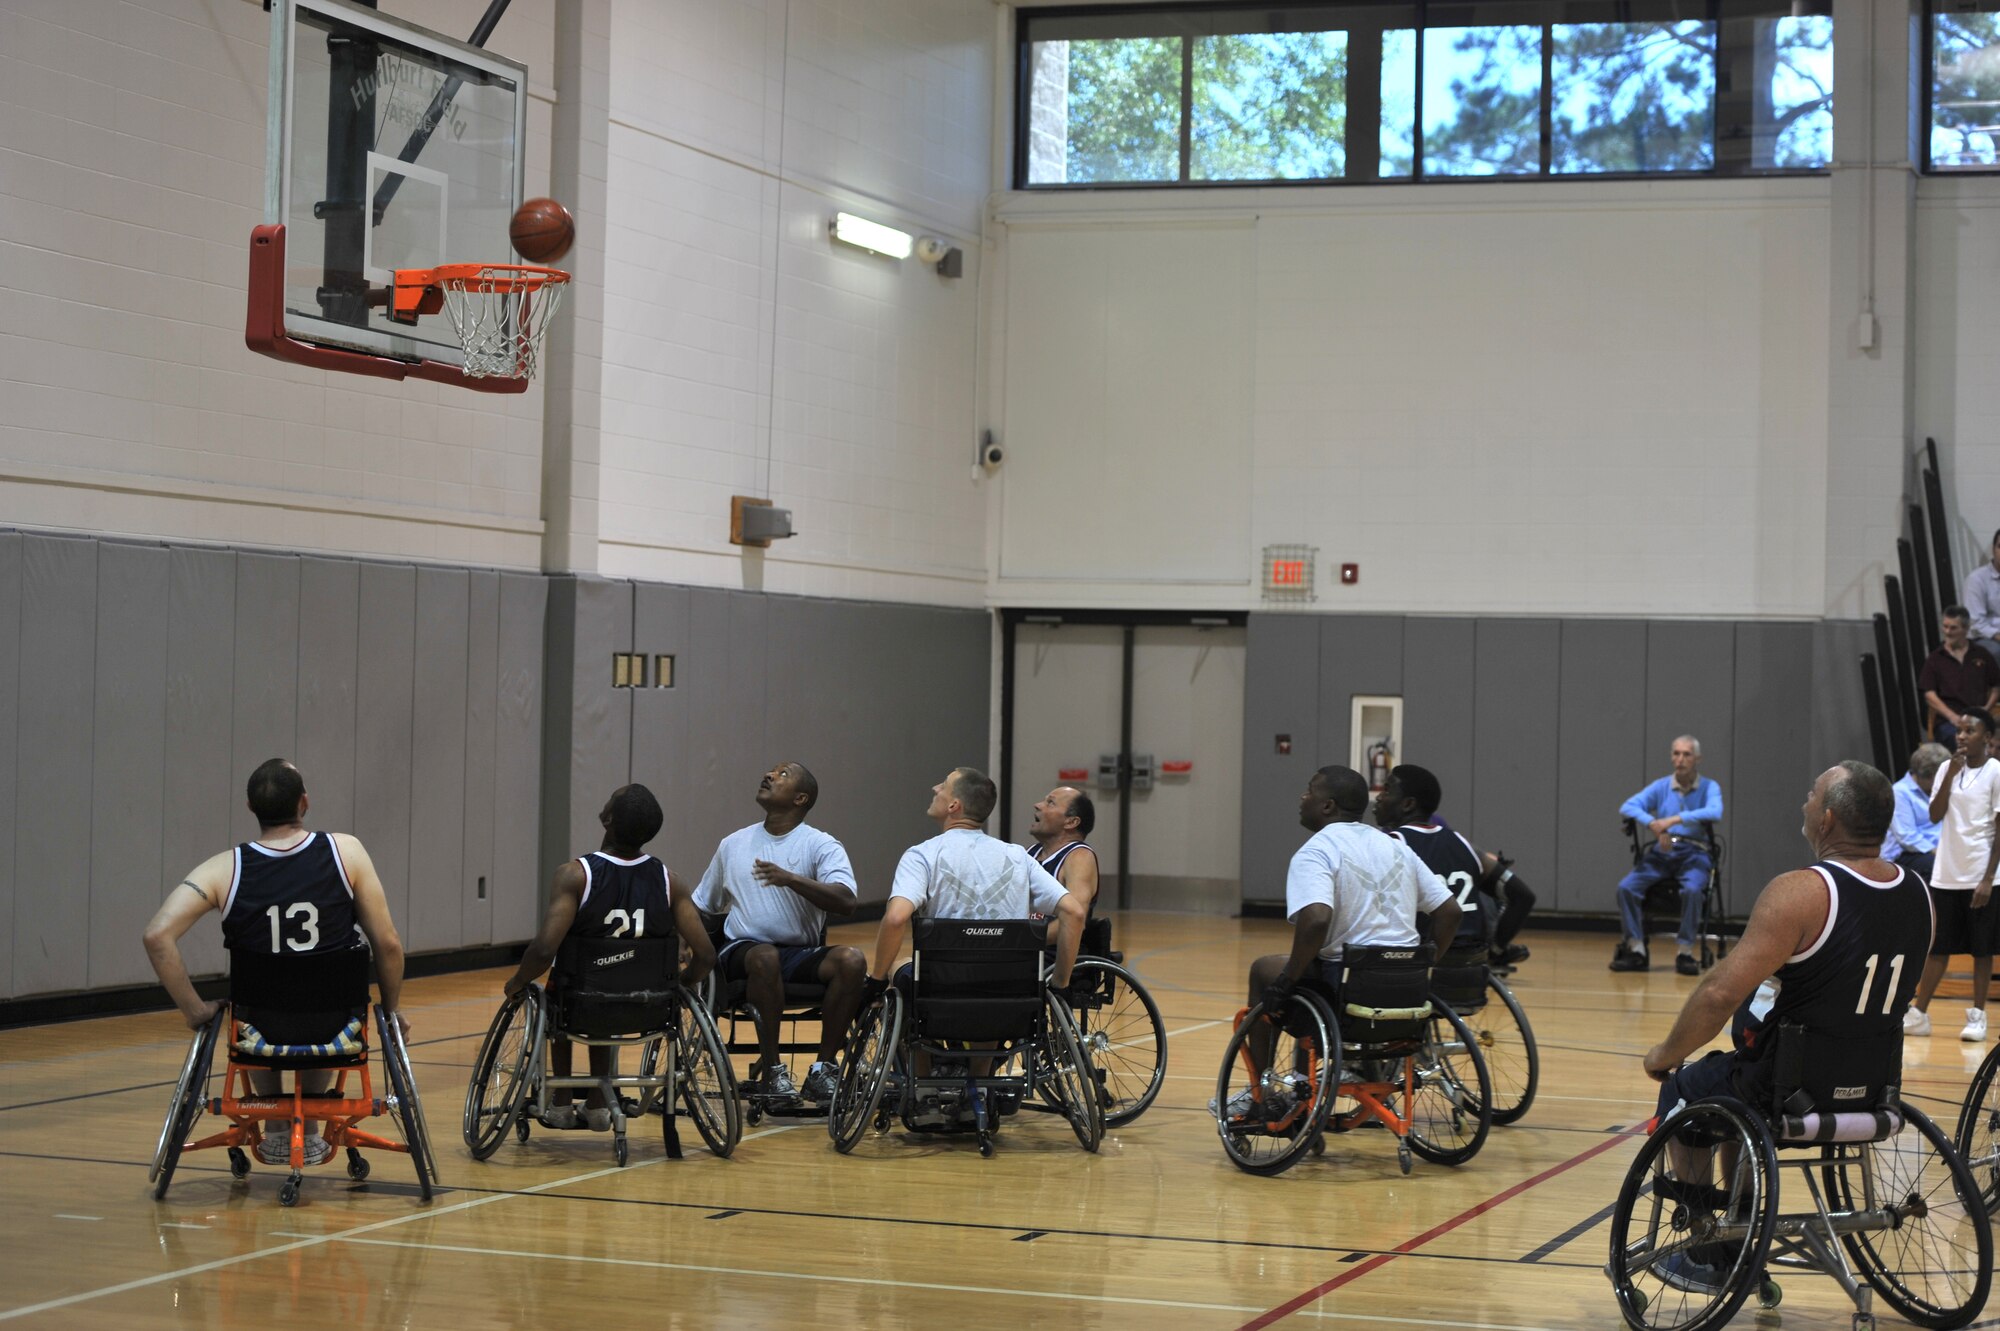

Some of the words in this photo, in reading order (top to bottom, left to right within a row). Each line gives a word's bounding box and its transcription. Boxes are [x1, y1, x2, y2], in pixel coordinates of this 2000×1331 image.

[349, 55, 425, 112] Hurlburt
[1272, 559, 1304, 585] EXIT
[1434, 870, 1478, 912] 2
[266, 901, 320, 954] 13
[603, 908, 645, 939] 21
[965, 927, 1004, 936] QUICKIE
[597, 950, 635, 966] QUICKIE
[1383, 951, 1415, 959] QUICKIE
[1855, 954, 1905, 1014] 11
